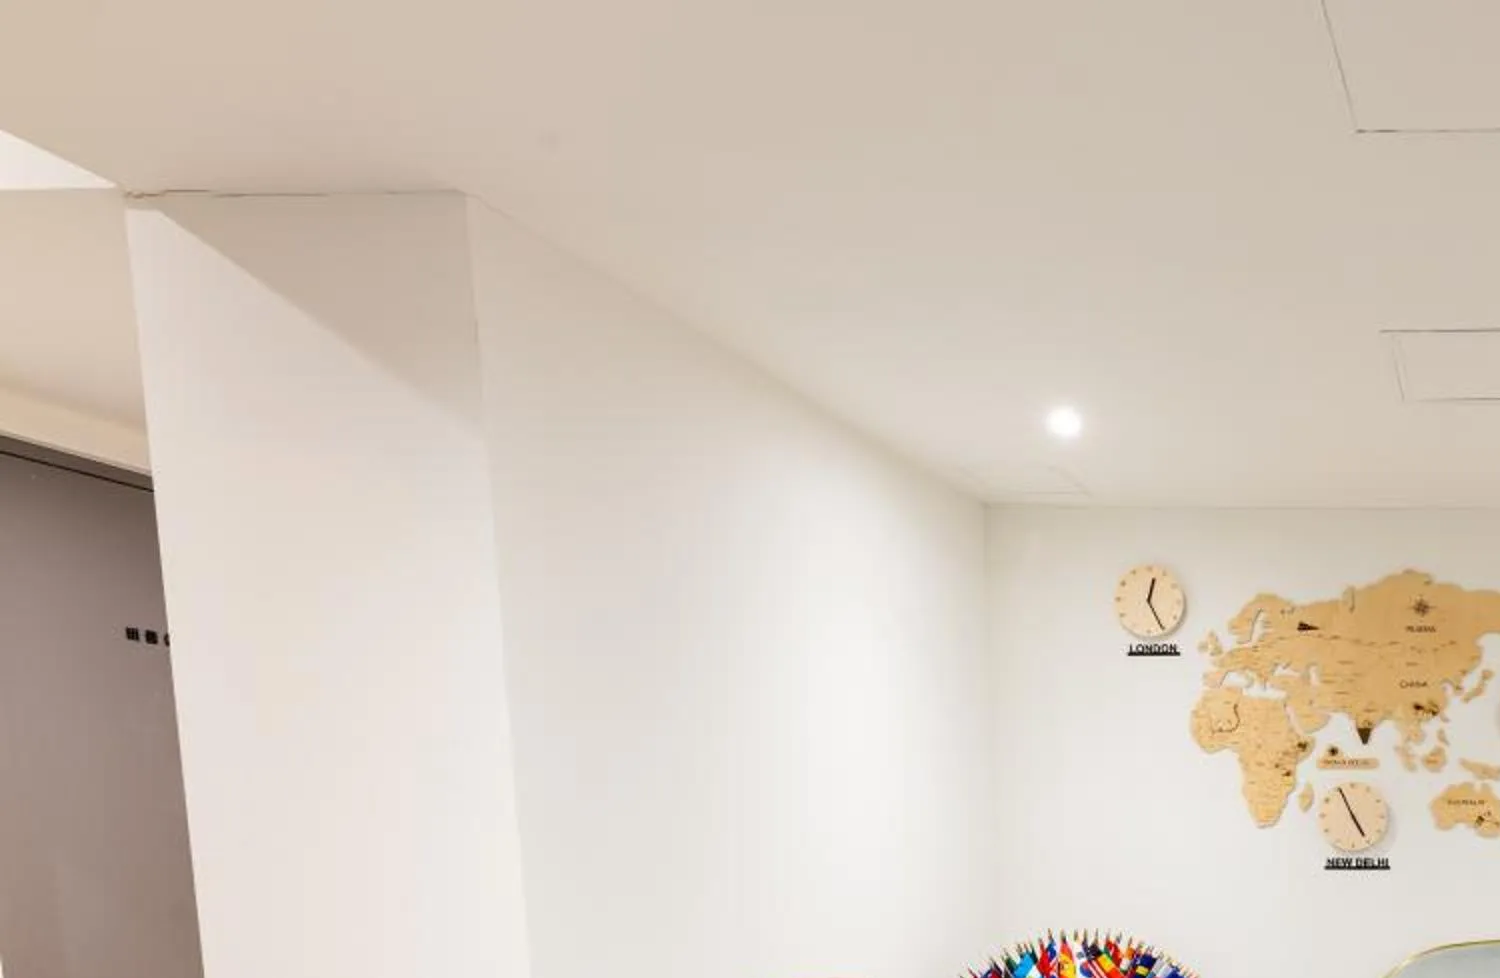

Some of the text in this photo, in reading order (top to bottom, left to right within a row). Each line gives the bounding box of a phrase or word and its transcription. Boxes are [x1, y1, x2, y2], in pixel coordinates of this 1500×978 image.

[1129, 643, 1177, 655] LONDON
[1326, 857, 1389, 868] NEW DELHI
